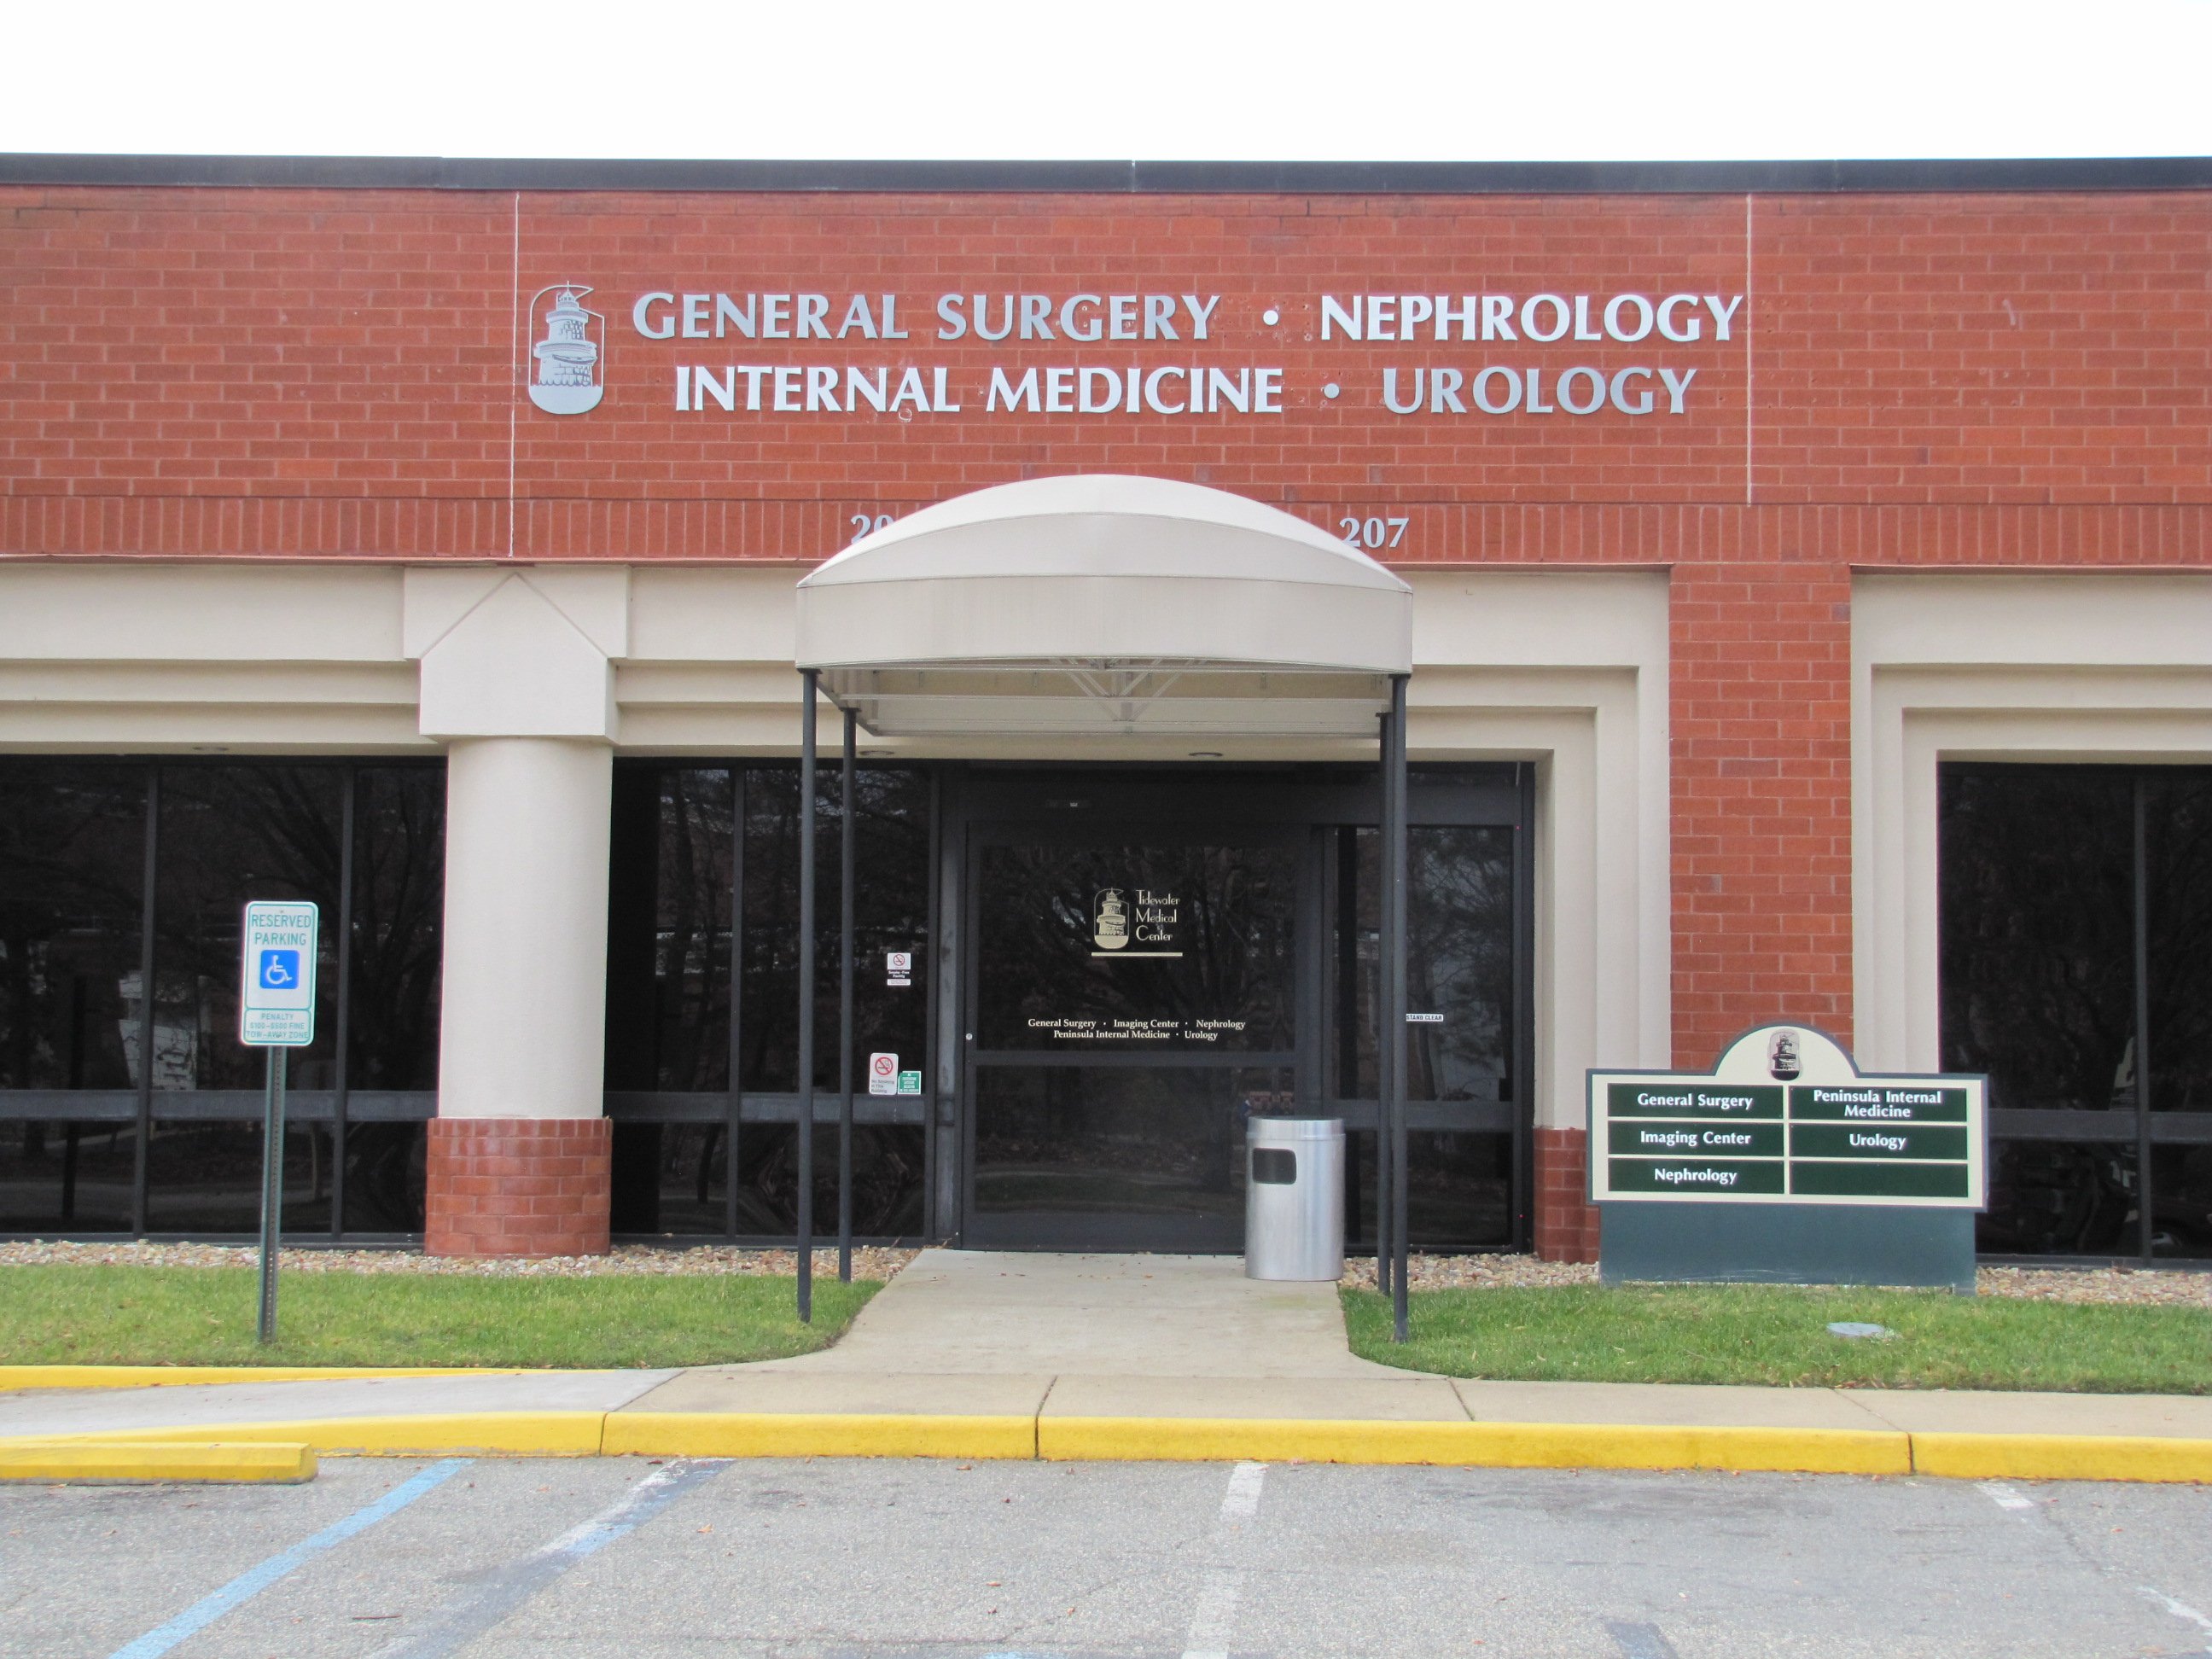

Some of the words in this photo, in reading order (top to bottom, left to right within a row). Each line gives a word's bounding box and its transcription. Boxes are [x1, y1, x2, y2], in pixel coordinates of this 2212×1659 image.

[633, 292, 909, 340] GENERAL
[937, 293, 1221, 341] SURGERY
[1320, 294, 1744, 341] NEPHROLOGY
[676, 365, 961, 412] INTERNAL
[986, 365, 1283, 414] MEDICINE
[1382, 366, 1698, 415] UROLOGY
[1339, 517, 1410, 549] 207
[1135, 889, 1180, 905] Tidewater
[251, 914, 311, 928] RESERVED
[1136, 907, 1177, 923] Medical
[254, 932, 306, 946] PARKING
[1135, 924, 1173, 941] Center
[1027, 1018, 1062, 1027] General
[1063, 1018, 1097, 1029] Surgery
[1114, 1019, 1149, 1030] Imaging
[1150, 1019, 1179, 1027] Center
[1196, 1019, 1246, 1031] Nephrology
[1053, 1029, 1094, 1039] Peninsula
[1096, 1029, 1129, 1039] Internal
[1131, 1030, 1170, 1039] Medicine
[1185, 1030, 1218, 1042] Urology
[1637, 1093, 1692, 1107] General
[1697, 1094, 1754, 1110] Surgery
[1813, 1089, 1879, 1103] Peninsula
[1885, 1091, 1942, 1104] Internal
[1843, 1103, 1912, 1118] Medicine
[1640, 1131, 1697, 1147] Imaging
[1703, 1131, 1752, 1144] Center
[1848, 1133, 1906, 1150] Urology
[1654, 1167, 1738, 1185] Nephrology
